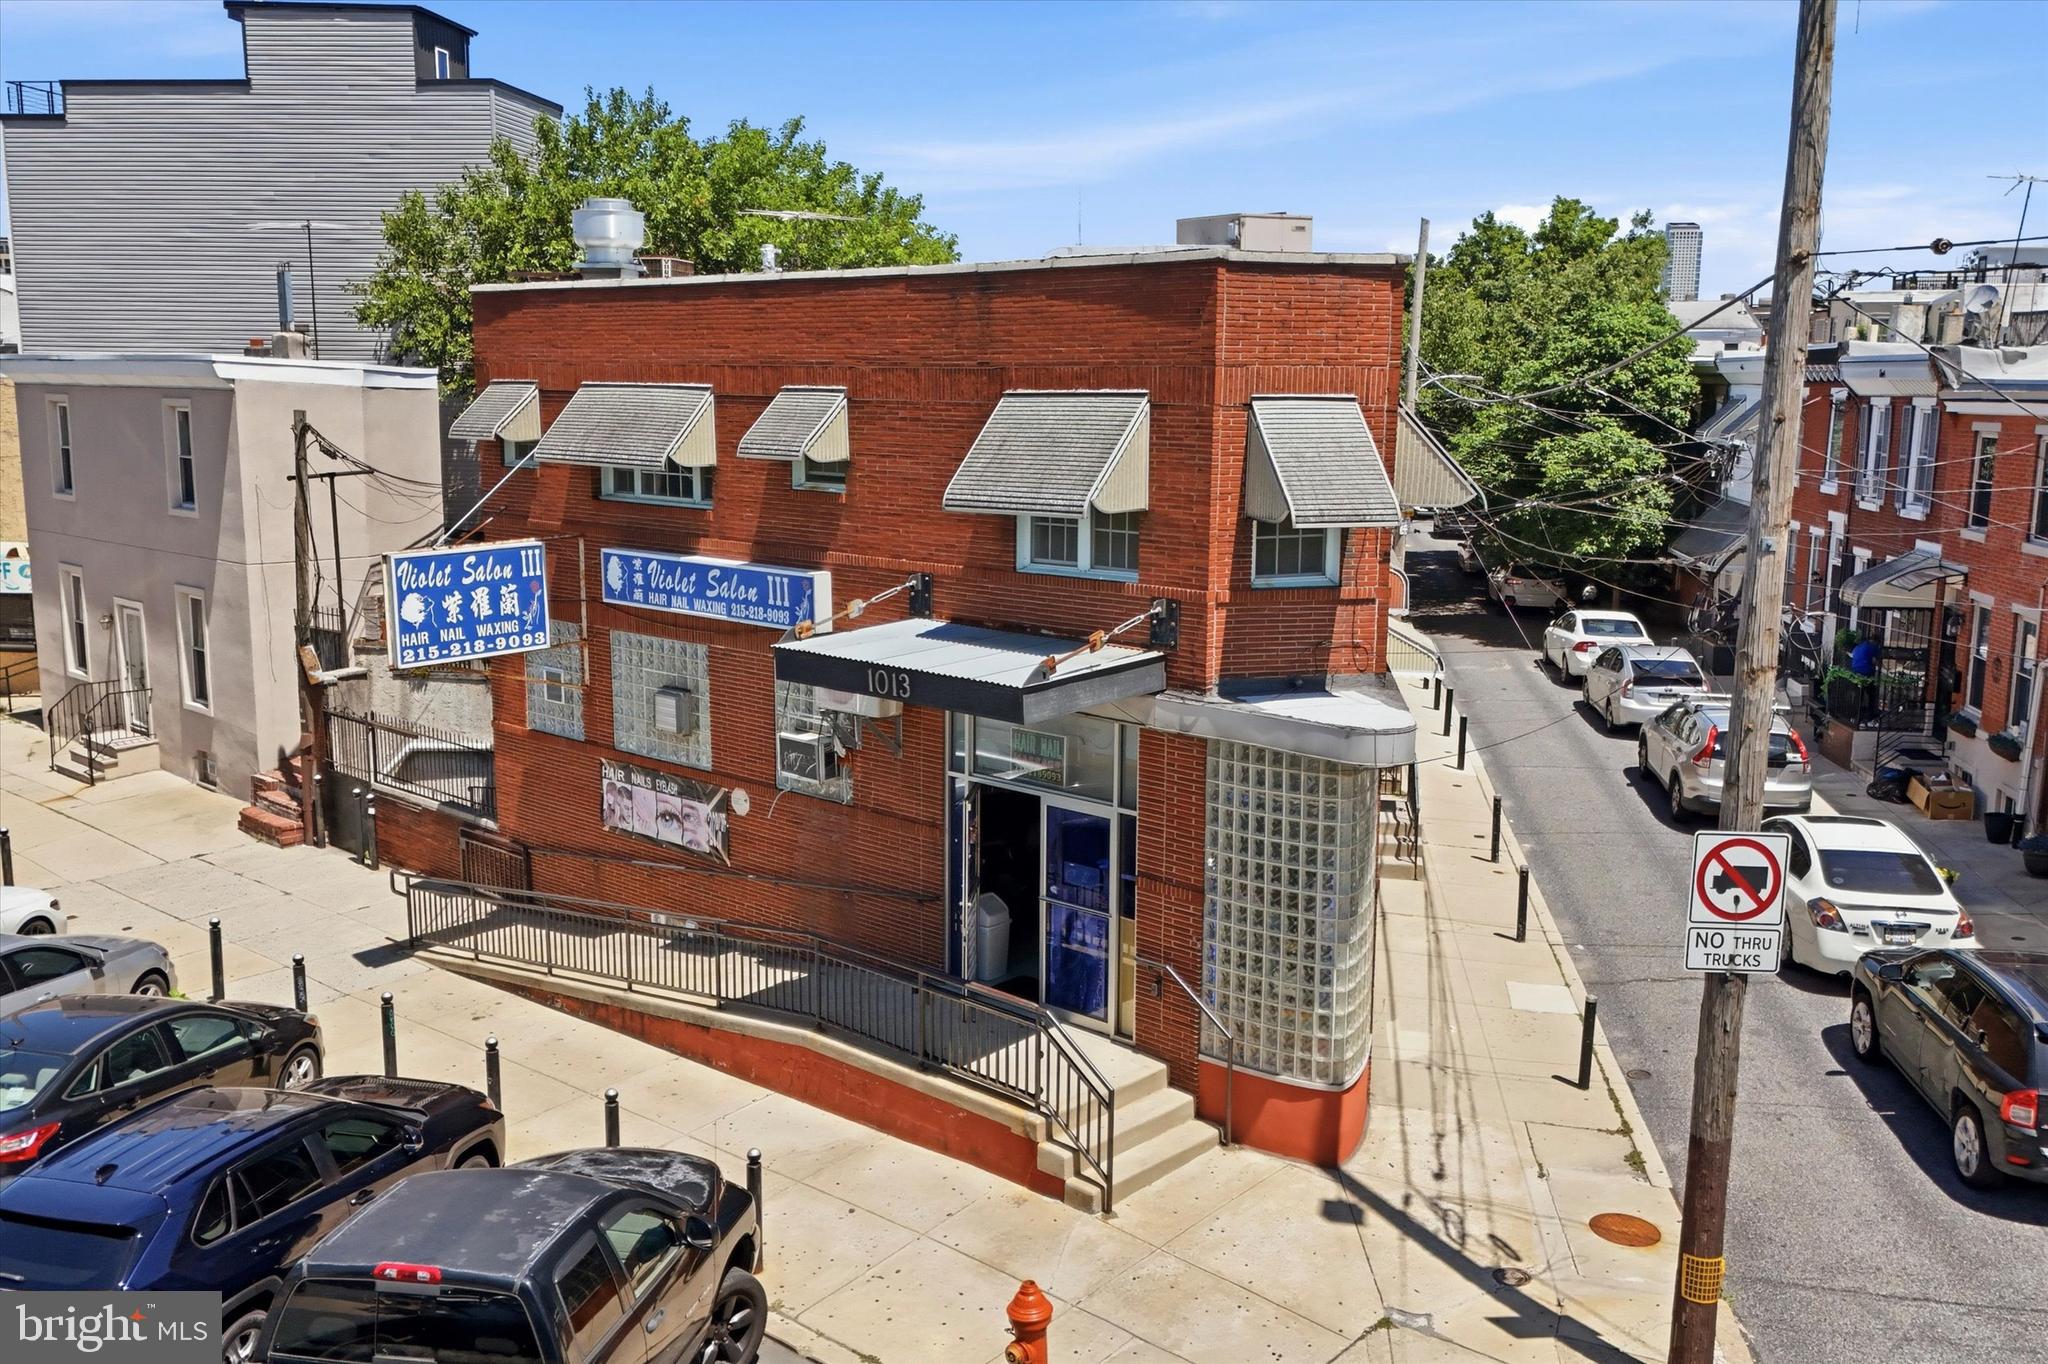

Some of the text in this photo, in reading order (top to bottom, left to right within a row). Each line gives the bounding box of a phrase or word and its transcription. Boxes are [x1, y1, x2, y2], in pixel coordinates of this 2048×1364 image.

[397, 548, 542, 591] Violet Salon III
[647, 560, 790, 607] Violet Salon III
[648, 591, 790, 625] HAIR NAIL WAXING 215-218-9093
[401, 620, 519, 647] HAIR NAIL WAXING
[402, 631, 545, 663] 215-218-9093
[867, 668, 911, 698] 1013
[1014, 731, 1036, 755] HAIR
[602, 765, 625, 782] HAIR
[631, 772, 652, 789] NAILS
[1695, 931, 1772, 951] NO THRU
[1704, 952, 1761, 968] TRUCKS
